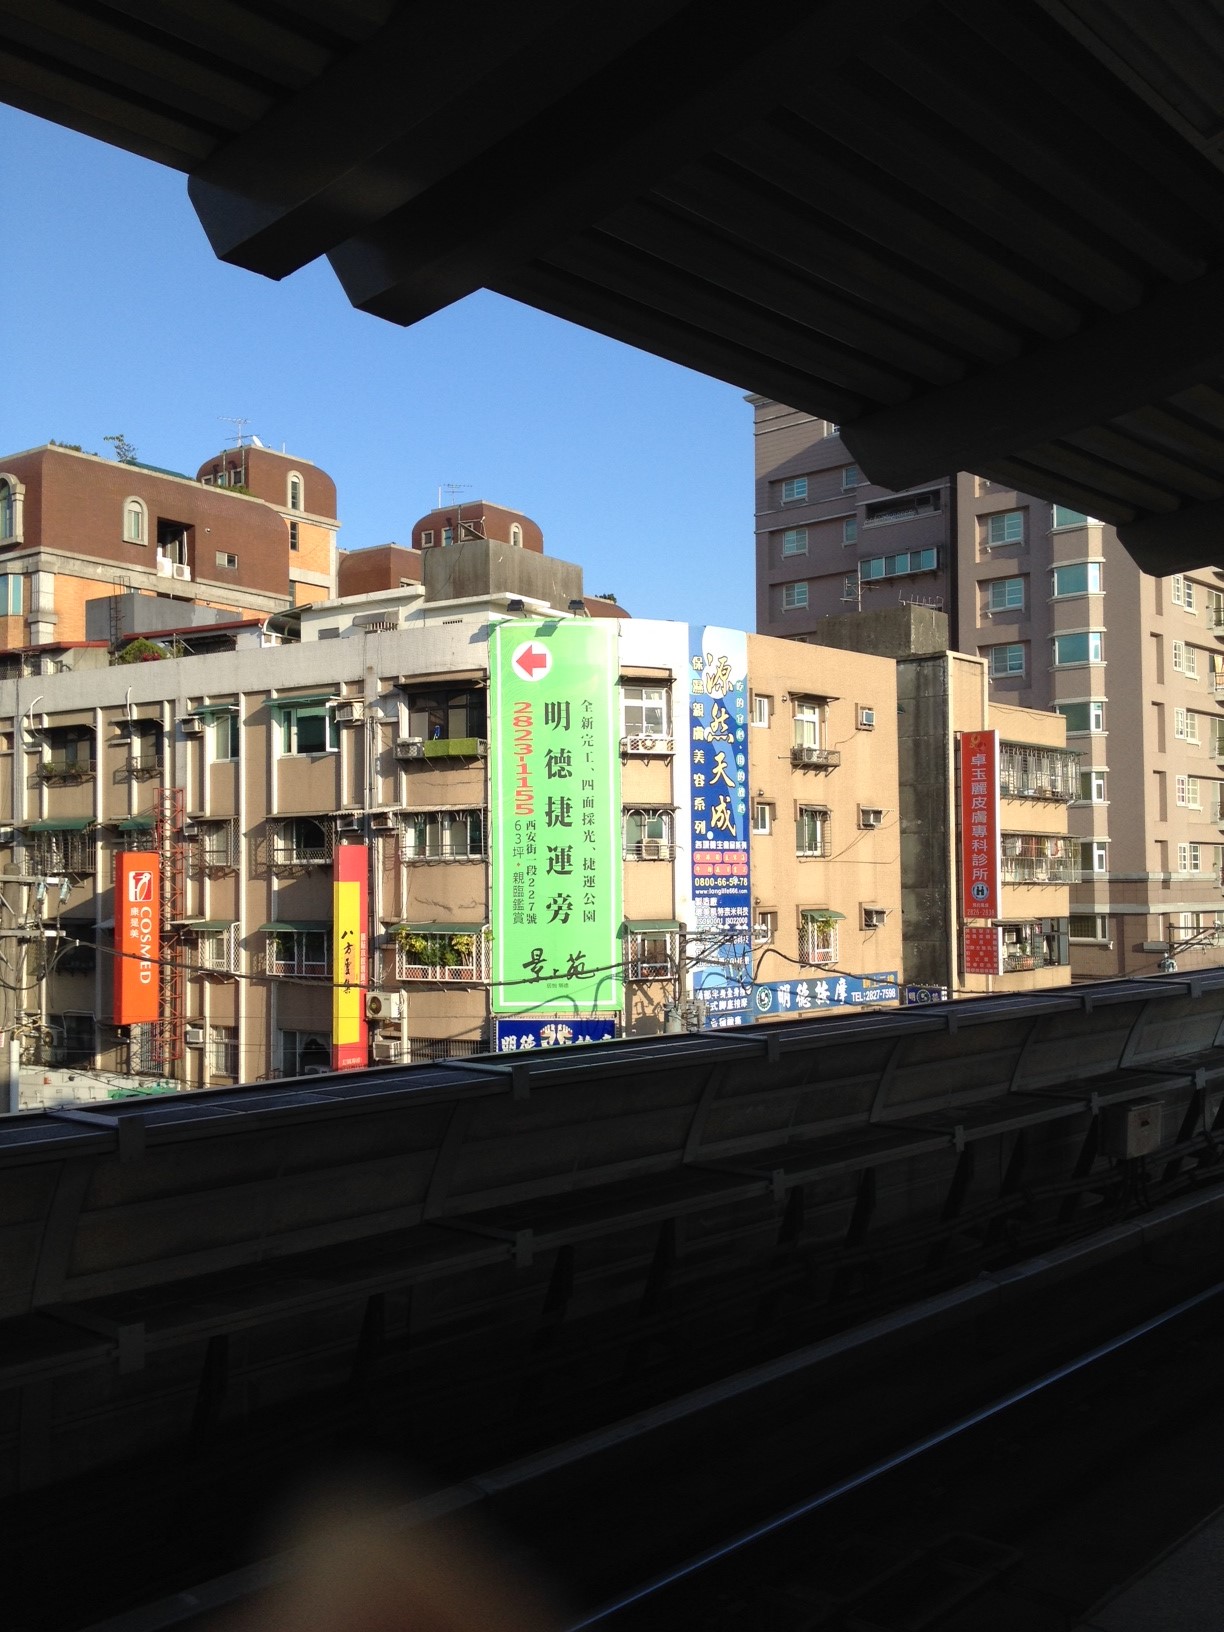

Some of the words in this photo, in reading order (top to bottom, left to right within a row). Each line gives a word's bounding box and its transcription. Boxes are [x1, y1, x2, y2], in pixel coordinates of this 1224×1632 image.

[513, 701, 535, 816] 2823-1155
[544, 700, 574, 925] 明德捷運旁
[526, 820, 538, 925] 西安街一段227號
[970, 753, 989, 881] 卓玉麗皮膚專科診所
[140, 906, 152, 984] COSMED
